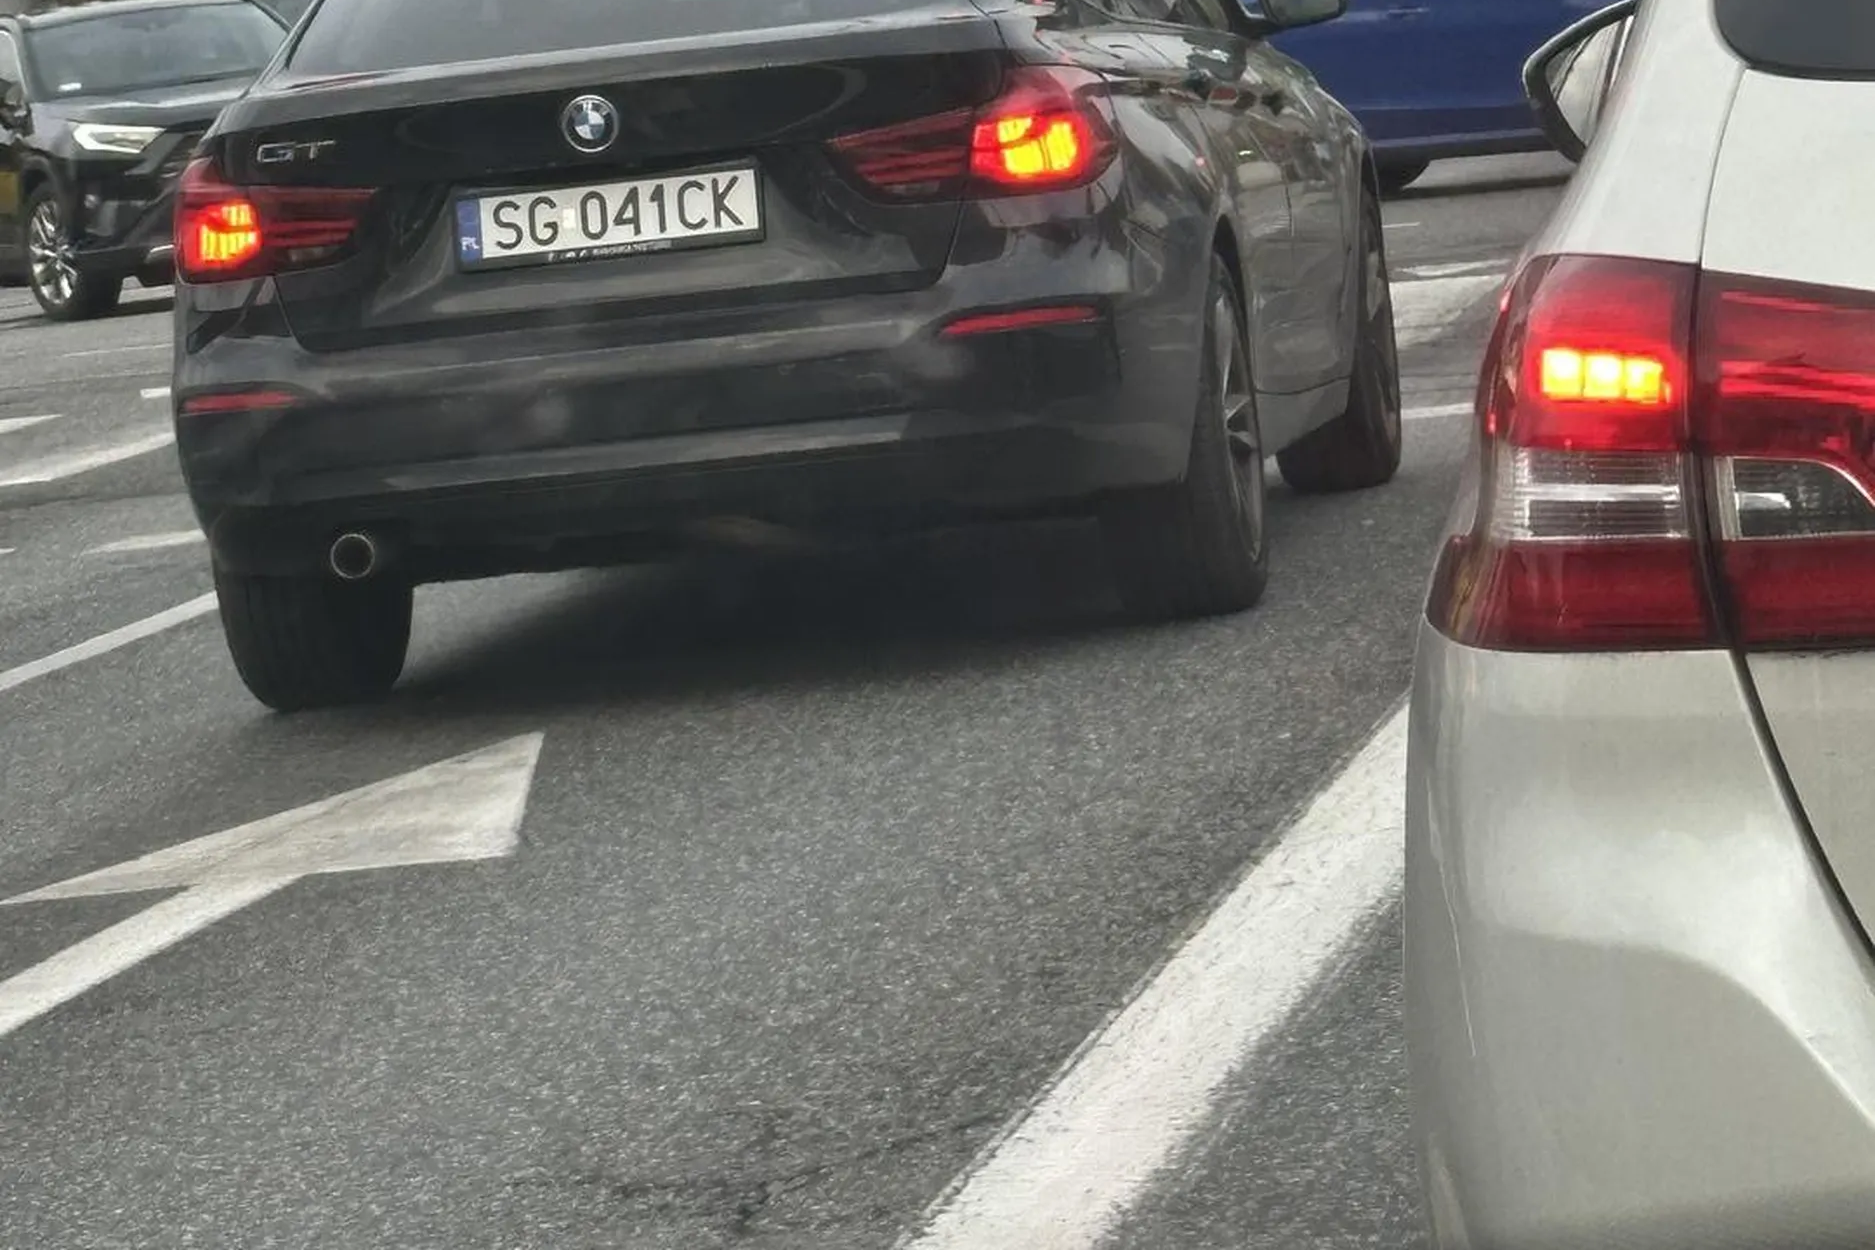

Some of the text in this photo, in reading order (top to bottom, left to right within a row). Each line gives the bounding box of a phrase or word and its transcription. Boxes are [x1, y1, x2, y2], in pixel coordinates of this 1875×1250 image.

[256, 139, 336, 163] GT
[492, 175, 745, 250] SG 041CK
